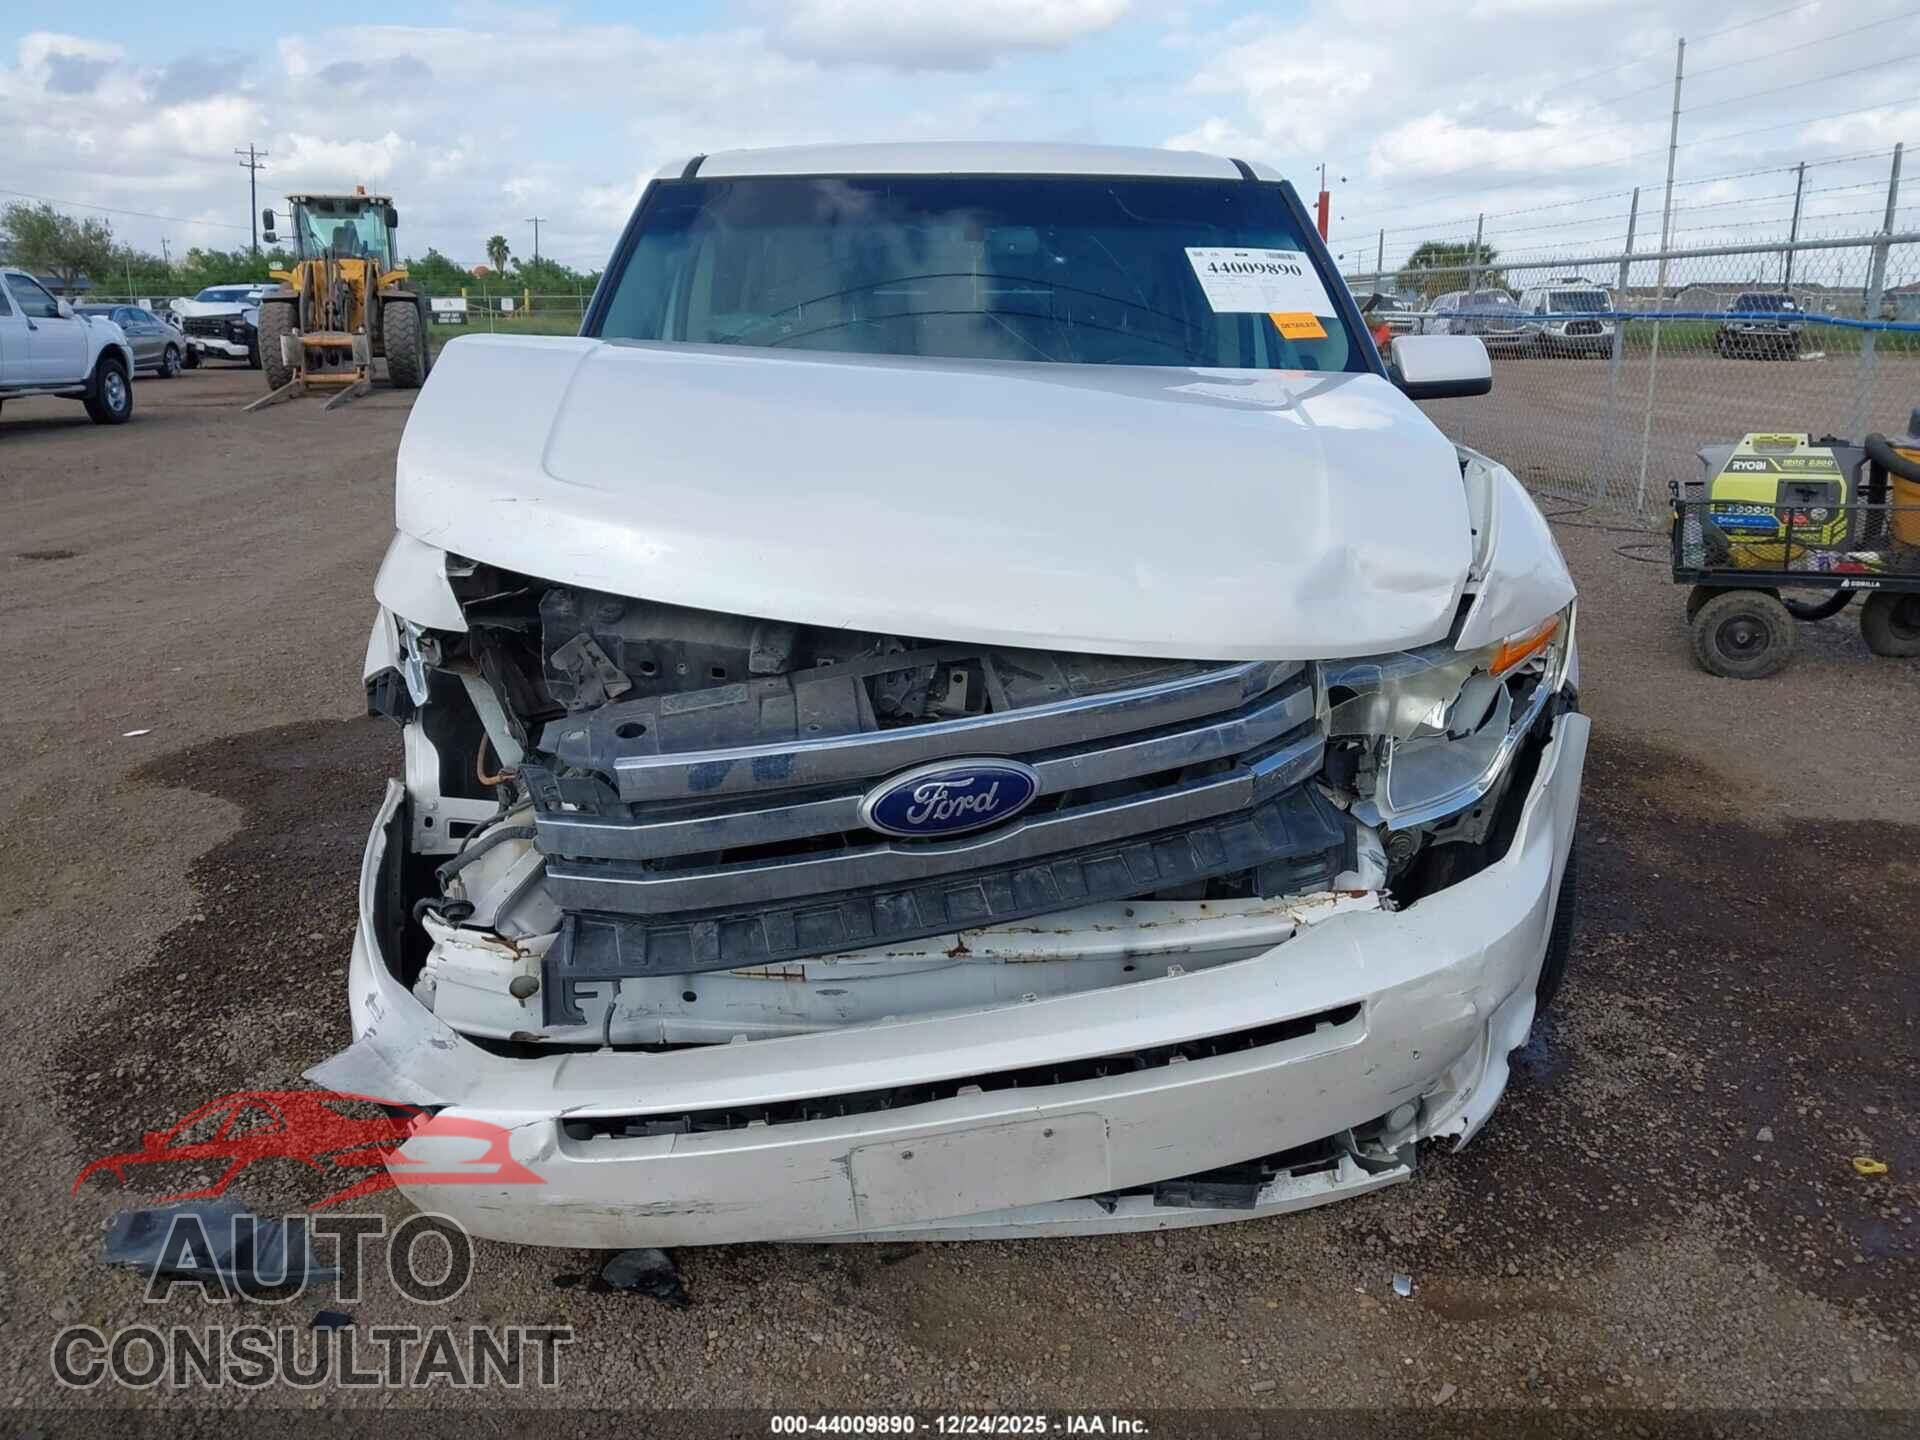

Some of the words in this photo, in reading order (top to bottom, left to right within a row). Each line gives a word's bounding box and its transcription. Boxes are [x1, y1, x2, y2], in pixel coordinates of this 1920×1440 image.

[1207, 261, 1302, 277] 44009890
[1732, 461, 1766, 470] RYOBI
[906, 777, 999, 824] Ford
